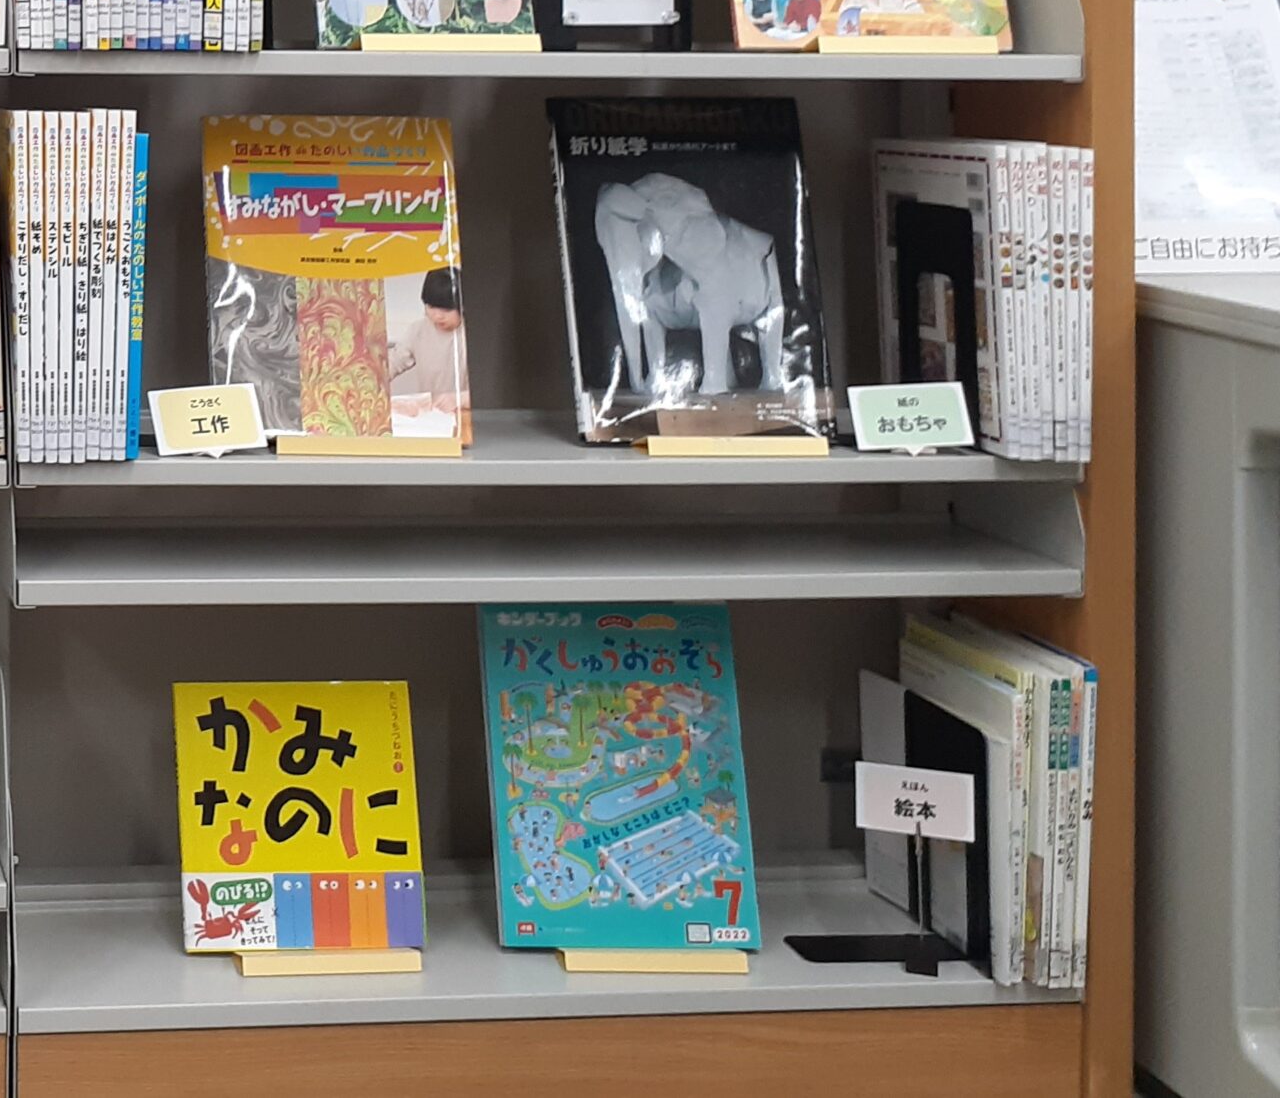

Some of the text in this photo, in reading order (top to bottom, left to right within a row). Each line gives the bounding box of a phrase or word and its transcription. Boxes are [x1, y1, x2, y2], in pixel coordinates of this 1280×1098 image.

[570, 135, 648, 156] 折り紙学
[228, 187, 442, 221] すみながし・マーブリング
[31, 222, 42, 254] 紙そめ
[47, 222, 58, 278] ステンシル
[62, 222, 72, 267] モビール
[105, 222, 117, 264] 紙はんが
[91, 219, 103, 299] 紙でつくる彫刻
[121, 221, 132, 299] うごくおもちゃ
[17, 221, 28, 336] こすりだし・すりだし
[190, 397, 221, 408] こうさく
[897, 397, 919, 407] 紙の
[191, 416, 230, 435] 工作
[877, 415, 947, 433] おもちゃ
[497, 612, 582, 627] キンダーブック
[501, 636, 722, 679] がくしゅうおおぞら
[196, 696, 358, 776] かみ
[901, 782, 929, 792] えほん
[194, 780, 408, 866] なのに
[894, 799, 936, 820] 絵本
[215, 881, 269, 902] のびる!?
[713, 880, 742, 926] 7
[717, 930, 747, 940] 2022
